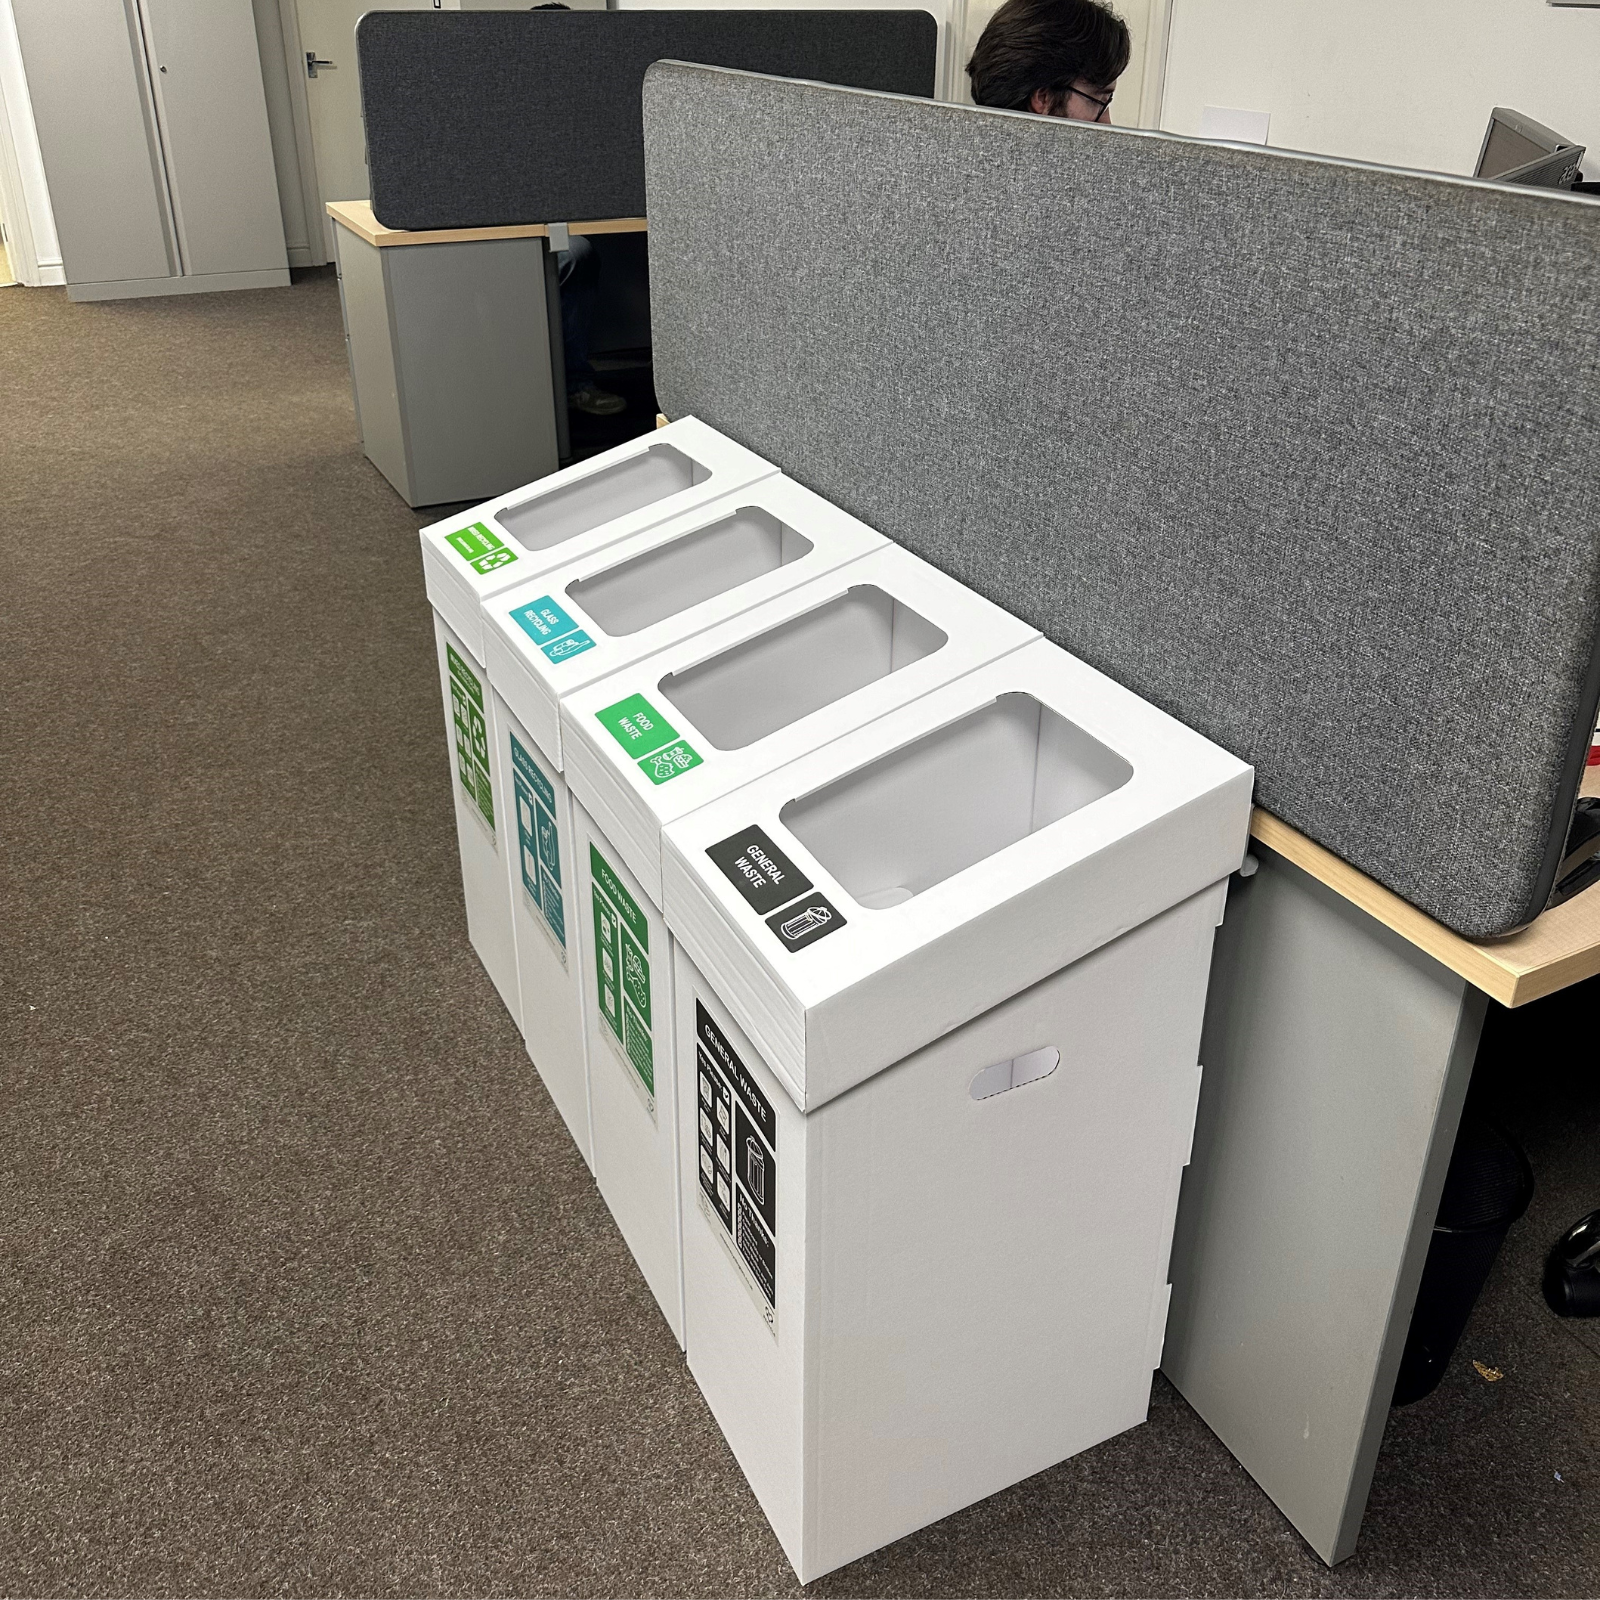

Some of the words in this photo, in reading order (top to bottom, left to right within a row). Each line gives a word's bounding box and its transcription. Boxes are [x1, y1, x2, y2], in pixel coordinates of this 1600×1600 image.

[523, 609, 551, 636] RECYCLING
[540, 608, 559, 625] GLASS
[618, 716, 643, 740] WASTE
[632, 711, 654, 731] FOOD
[735, 856, 766, 889] WASTE
[746, 844, 785, 885] GENERAL
[601, 868, 617, 895] FOOD
[617, 889, 637, 924] WASTE
[704, 1024, 739, 1081] GENERAL
[739, 1073, 767, 1123] WASTE
